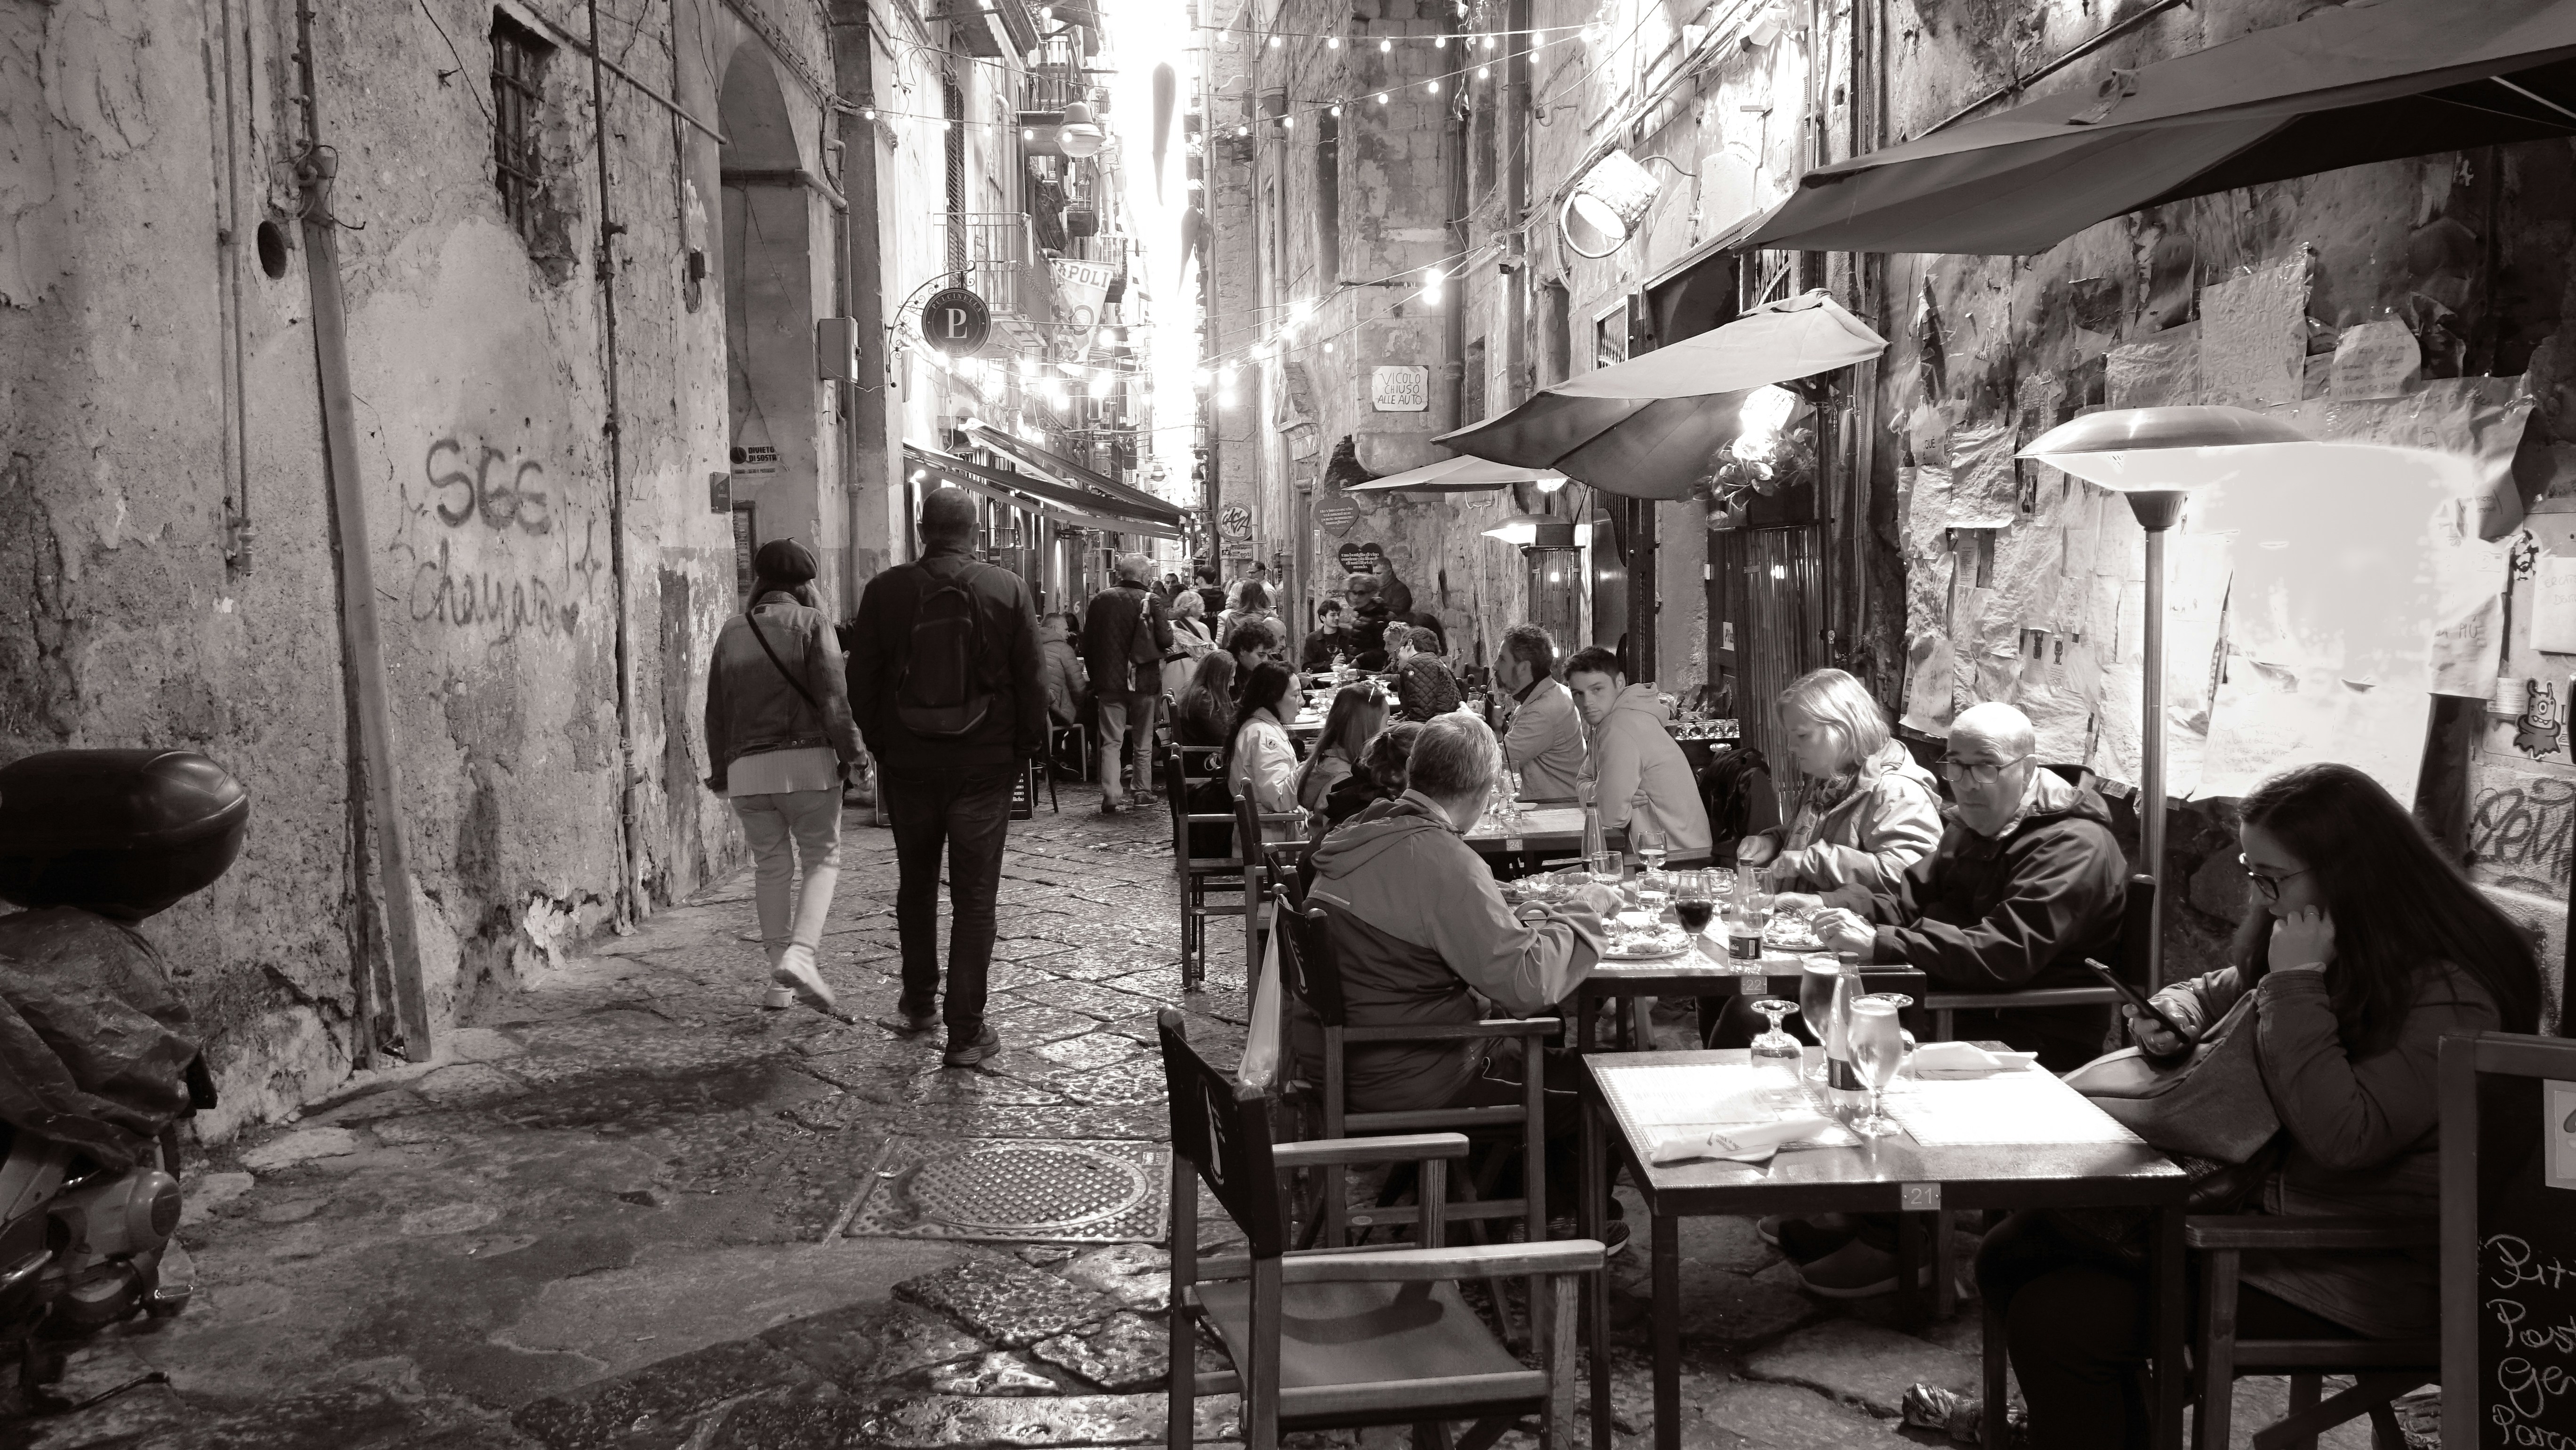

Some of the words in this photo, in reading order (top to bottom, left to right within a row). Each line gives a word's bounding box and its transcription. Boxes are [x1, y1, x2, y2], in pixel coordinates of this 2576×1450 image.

[932, 293, 982, 313] PULCINELLA
[1380, 373, 1421, 385] VICOLO
[1385, 384, 1420, 394] CHIUSO
[1377, 395, 1396, 404] ALLE
[1398, 395, 1422, 405] AUTO
[1074, 601, 1080, 614] 6
[1509, 841, 1520, 849] 24
[1746, 978, 1762, 991] 22
[1910, 1187, 1932, 1205] 21
